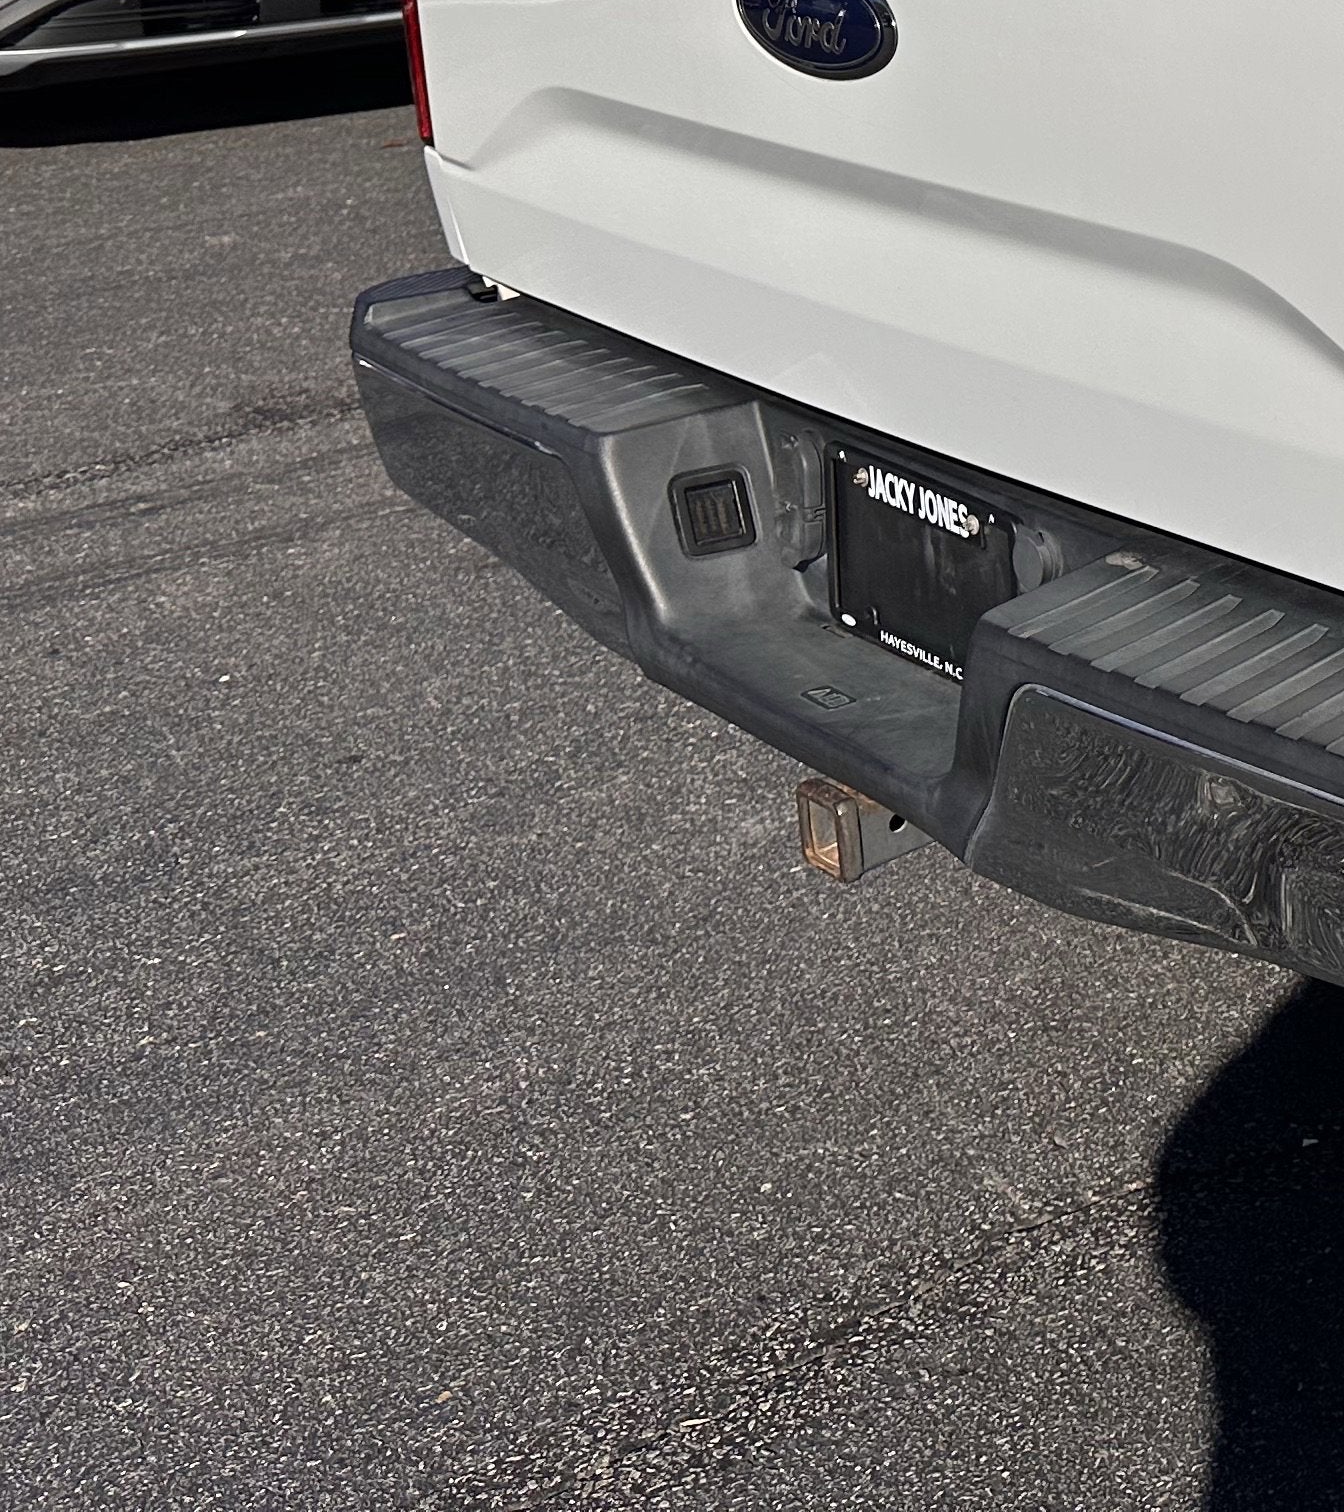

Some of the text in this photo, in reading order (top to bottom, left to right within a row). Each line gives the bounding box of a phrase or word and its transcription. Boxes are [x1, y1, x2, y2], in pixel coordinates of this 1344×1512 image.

[868, 465, 971, 539] JACKY JONES
[880, 630, 944, 670] HAYESVILLE,
